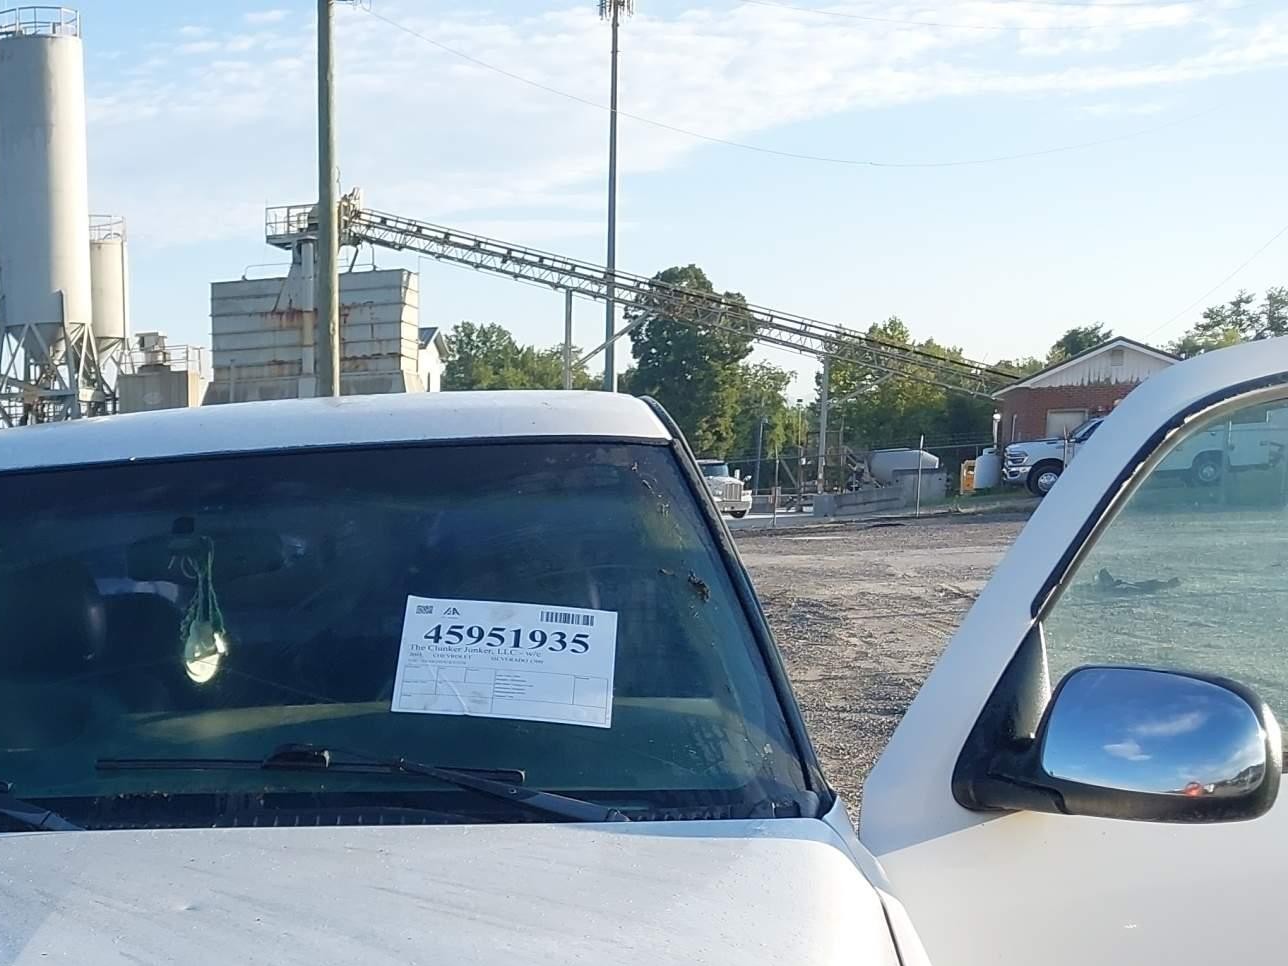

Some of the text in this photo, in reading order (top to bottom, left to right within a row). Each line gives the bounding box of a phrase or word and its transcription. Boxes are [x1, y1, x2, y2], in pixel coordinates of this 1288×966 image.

[409, 643, 426, 651] The
[427, 644, 462, 653] Clunker
[497, 647, 518, 656] LLC
[423, 623, 590, 654] 45951935
